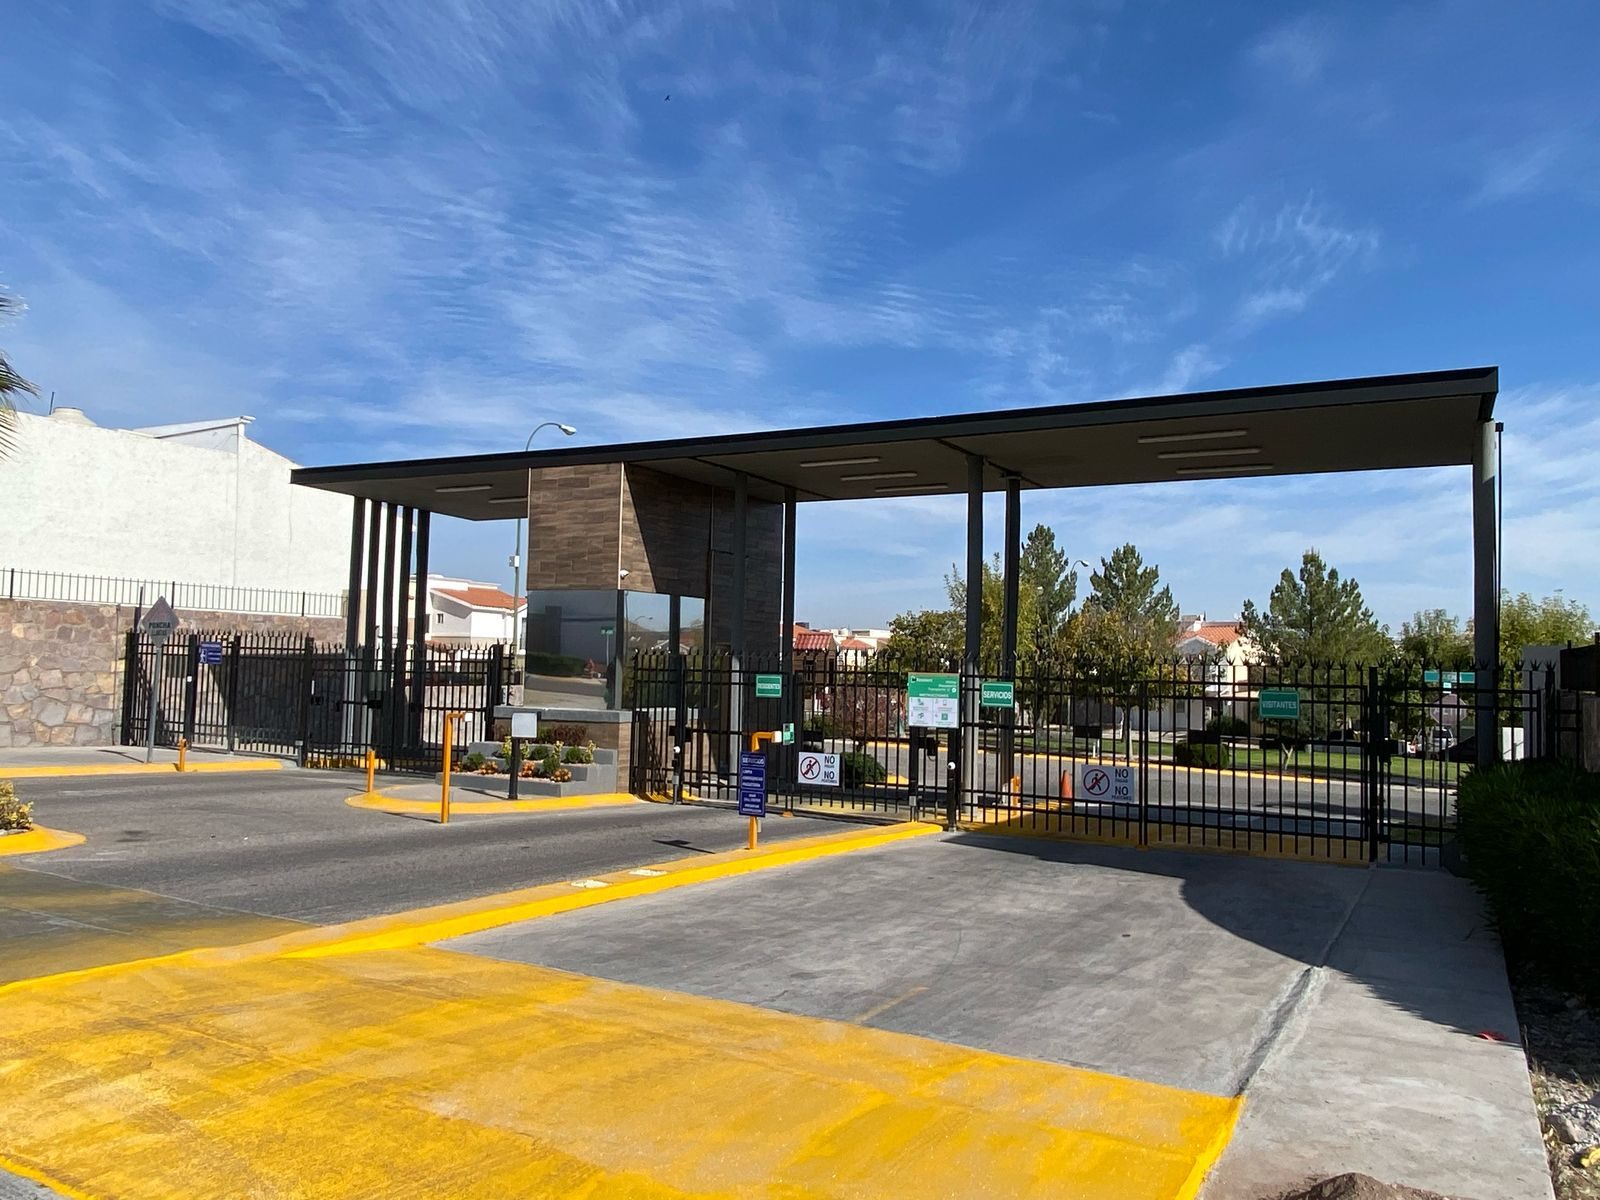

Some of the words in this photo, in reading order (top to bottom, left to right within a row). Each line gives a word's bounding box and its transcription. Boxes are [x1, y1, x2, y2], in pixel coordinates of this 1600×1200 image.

[983, 690, 1012, 700] SERVICIOS
[1262, 701, 1297, 709] VISITANTES
[824, 755, 836, 765] NO
[823, 770, 835, 780] NO
[1115, 768, 1129, 779] NO
[1115, 786, 1129, 796] NO
